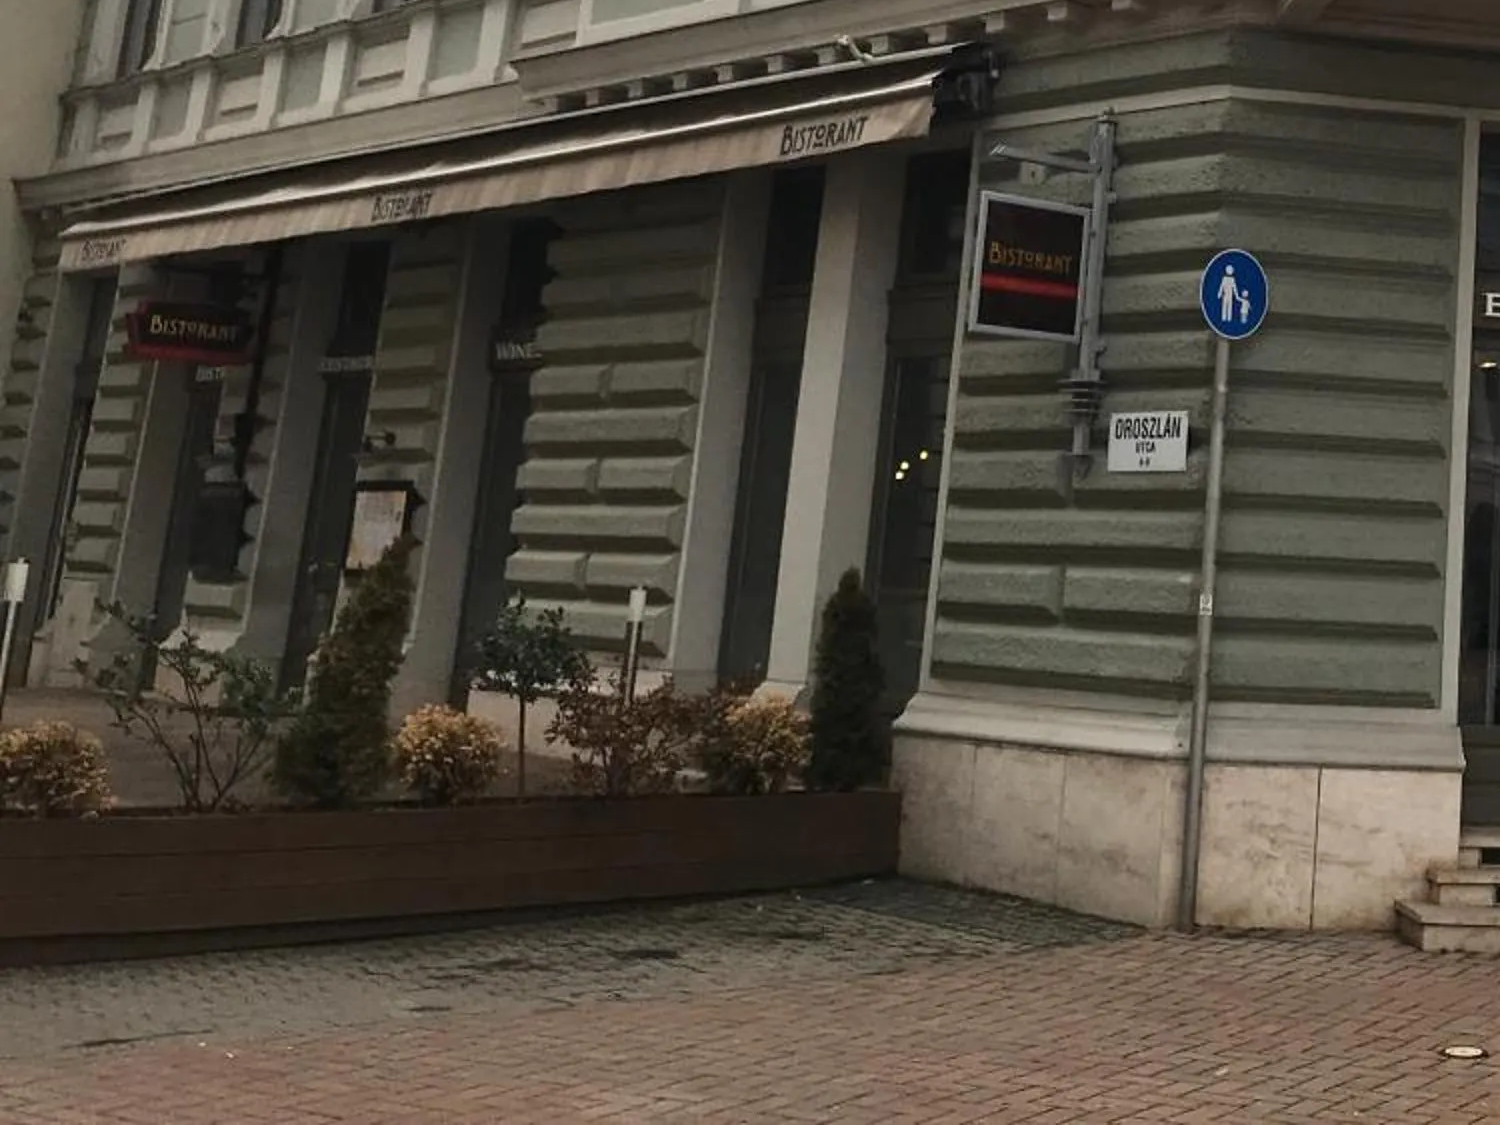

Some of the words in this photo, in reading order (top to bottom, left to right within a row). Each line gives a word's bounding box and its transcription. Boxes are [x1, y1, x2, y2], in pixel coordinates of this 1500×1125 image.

[780, 116, 869, 155] BISTORANT
[989, 240, 1073, 275] BISTORANT
[149, 314, 240, 343] BISTORANT
[1115, 413, 1181, 440] OROSZLÁN
